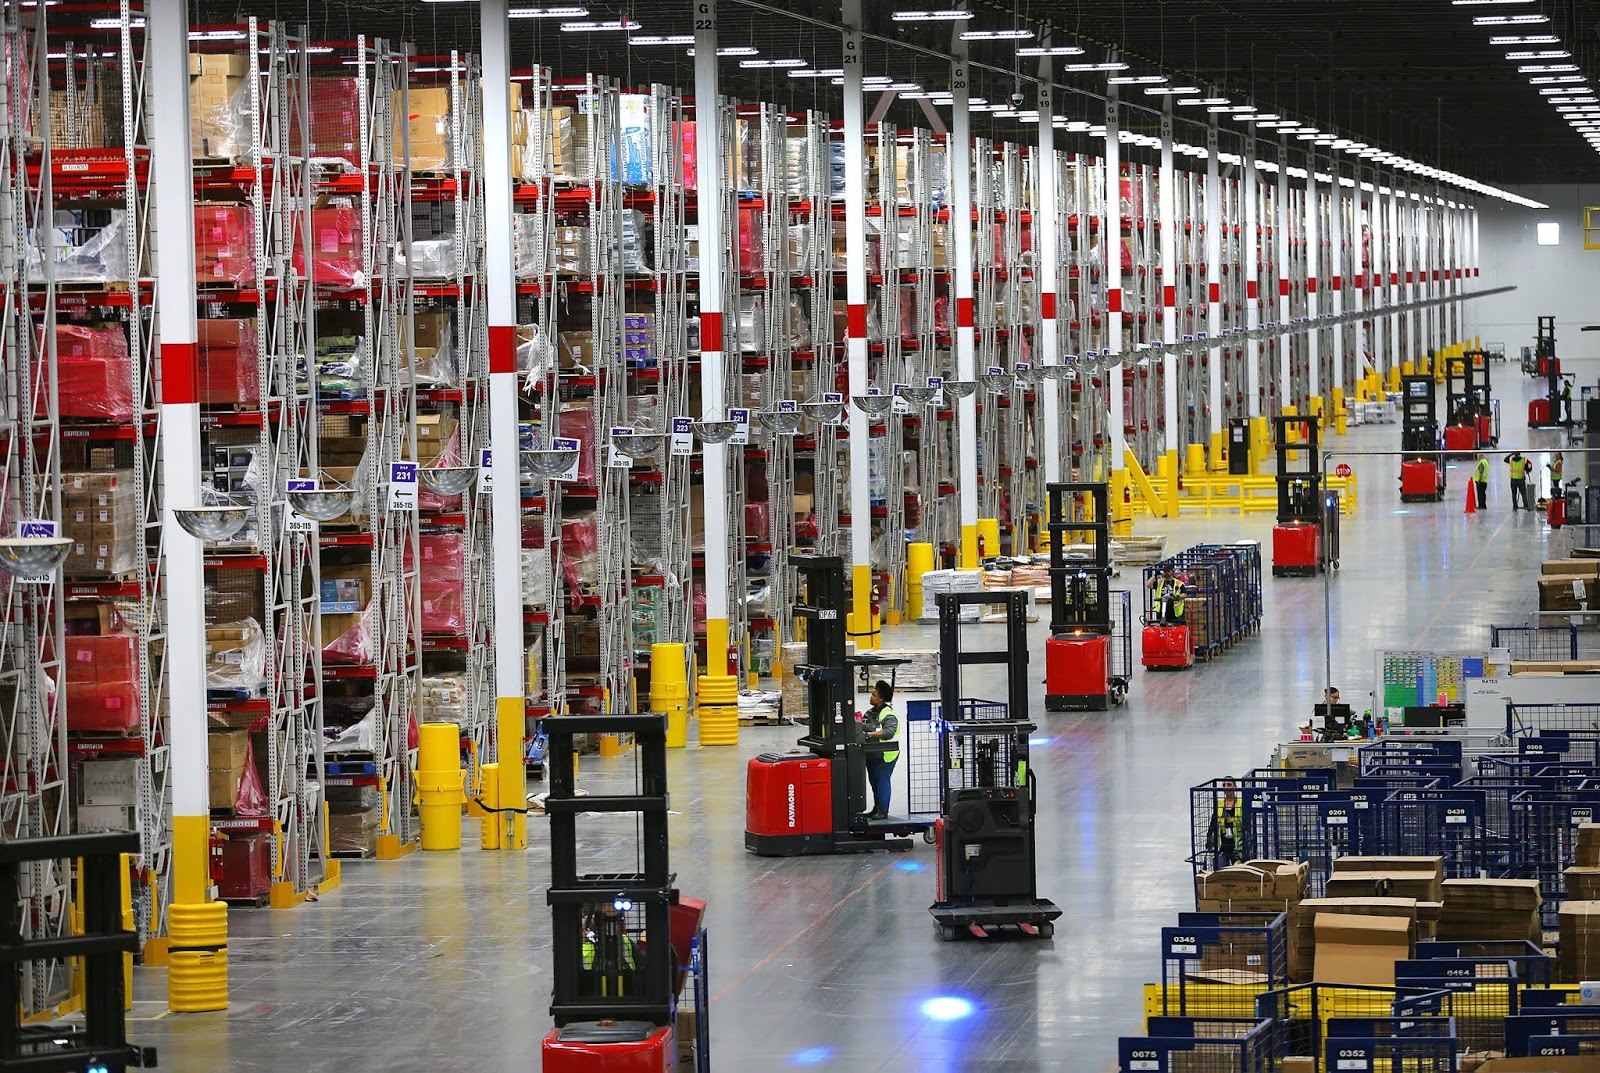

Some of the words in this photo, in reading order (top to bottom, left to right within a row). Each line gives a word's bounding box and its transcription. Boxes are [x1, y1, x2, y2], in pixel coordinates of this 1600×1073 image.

[698, 4, 708, 14] G
[696, 20, 712, 29] 22
[846, 42, 855, 50] G
[955, 69, 963, 77] G
[396, 472, 411, 480] 231
[1336, 468, 1350, 476] STOP
[788, 783, 796, 828] RAYMOND
[1132, 1050, 1157, 1058] 0675
